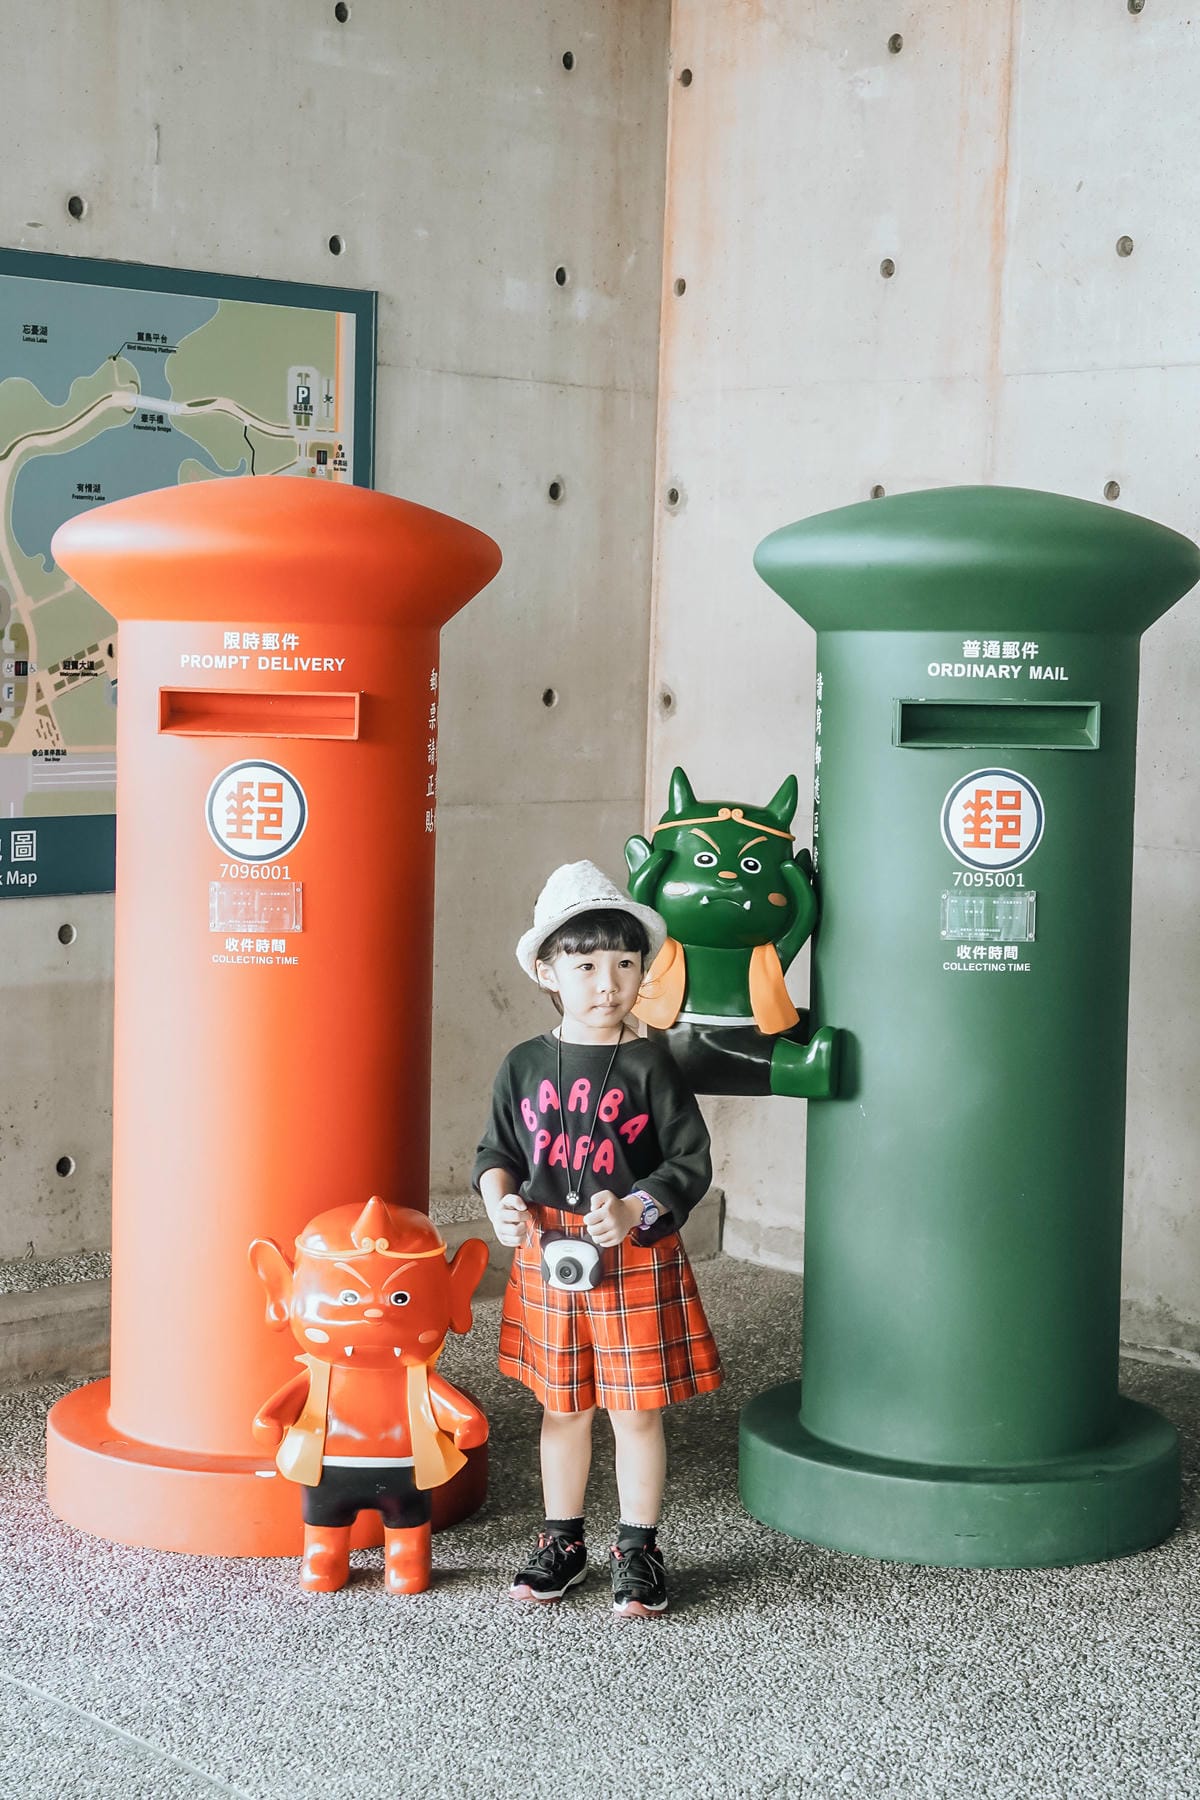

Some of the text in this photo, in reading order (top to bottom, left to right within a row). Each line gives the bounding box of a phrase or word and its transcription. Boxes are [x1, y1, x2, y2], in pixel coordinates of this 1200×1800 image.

[298, 387, 309, 403] P
[223, 632, 300, 651] 限時郵件
[962, 640, 1039, 660] 普通郵件
[180, 654, 346, 672] PROMPT DELIVERY
[927, 662, 1069, 681] ORDINARY MAIL
[0, 830, 37, 862] 圖
[6, 870, 38, 887] Map
[219, 863, 291, 880] 7096001
[952, 871, 1025, 888] 7095001
[225, 938, 286, 954] 收件時間
[956, 945, 1019, 960] 收件時間
[212, 955, 298, 965] COLLECTING TIME
[943, 962, 1031, 972] COLLECTING TIME
[520, 1077, 649, 1144] BARBA
[533, 1129, 615, 1175] PAPA
